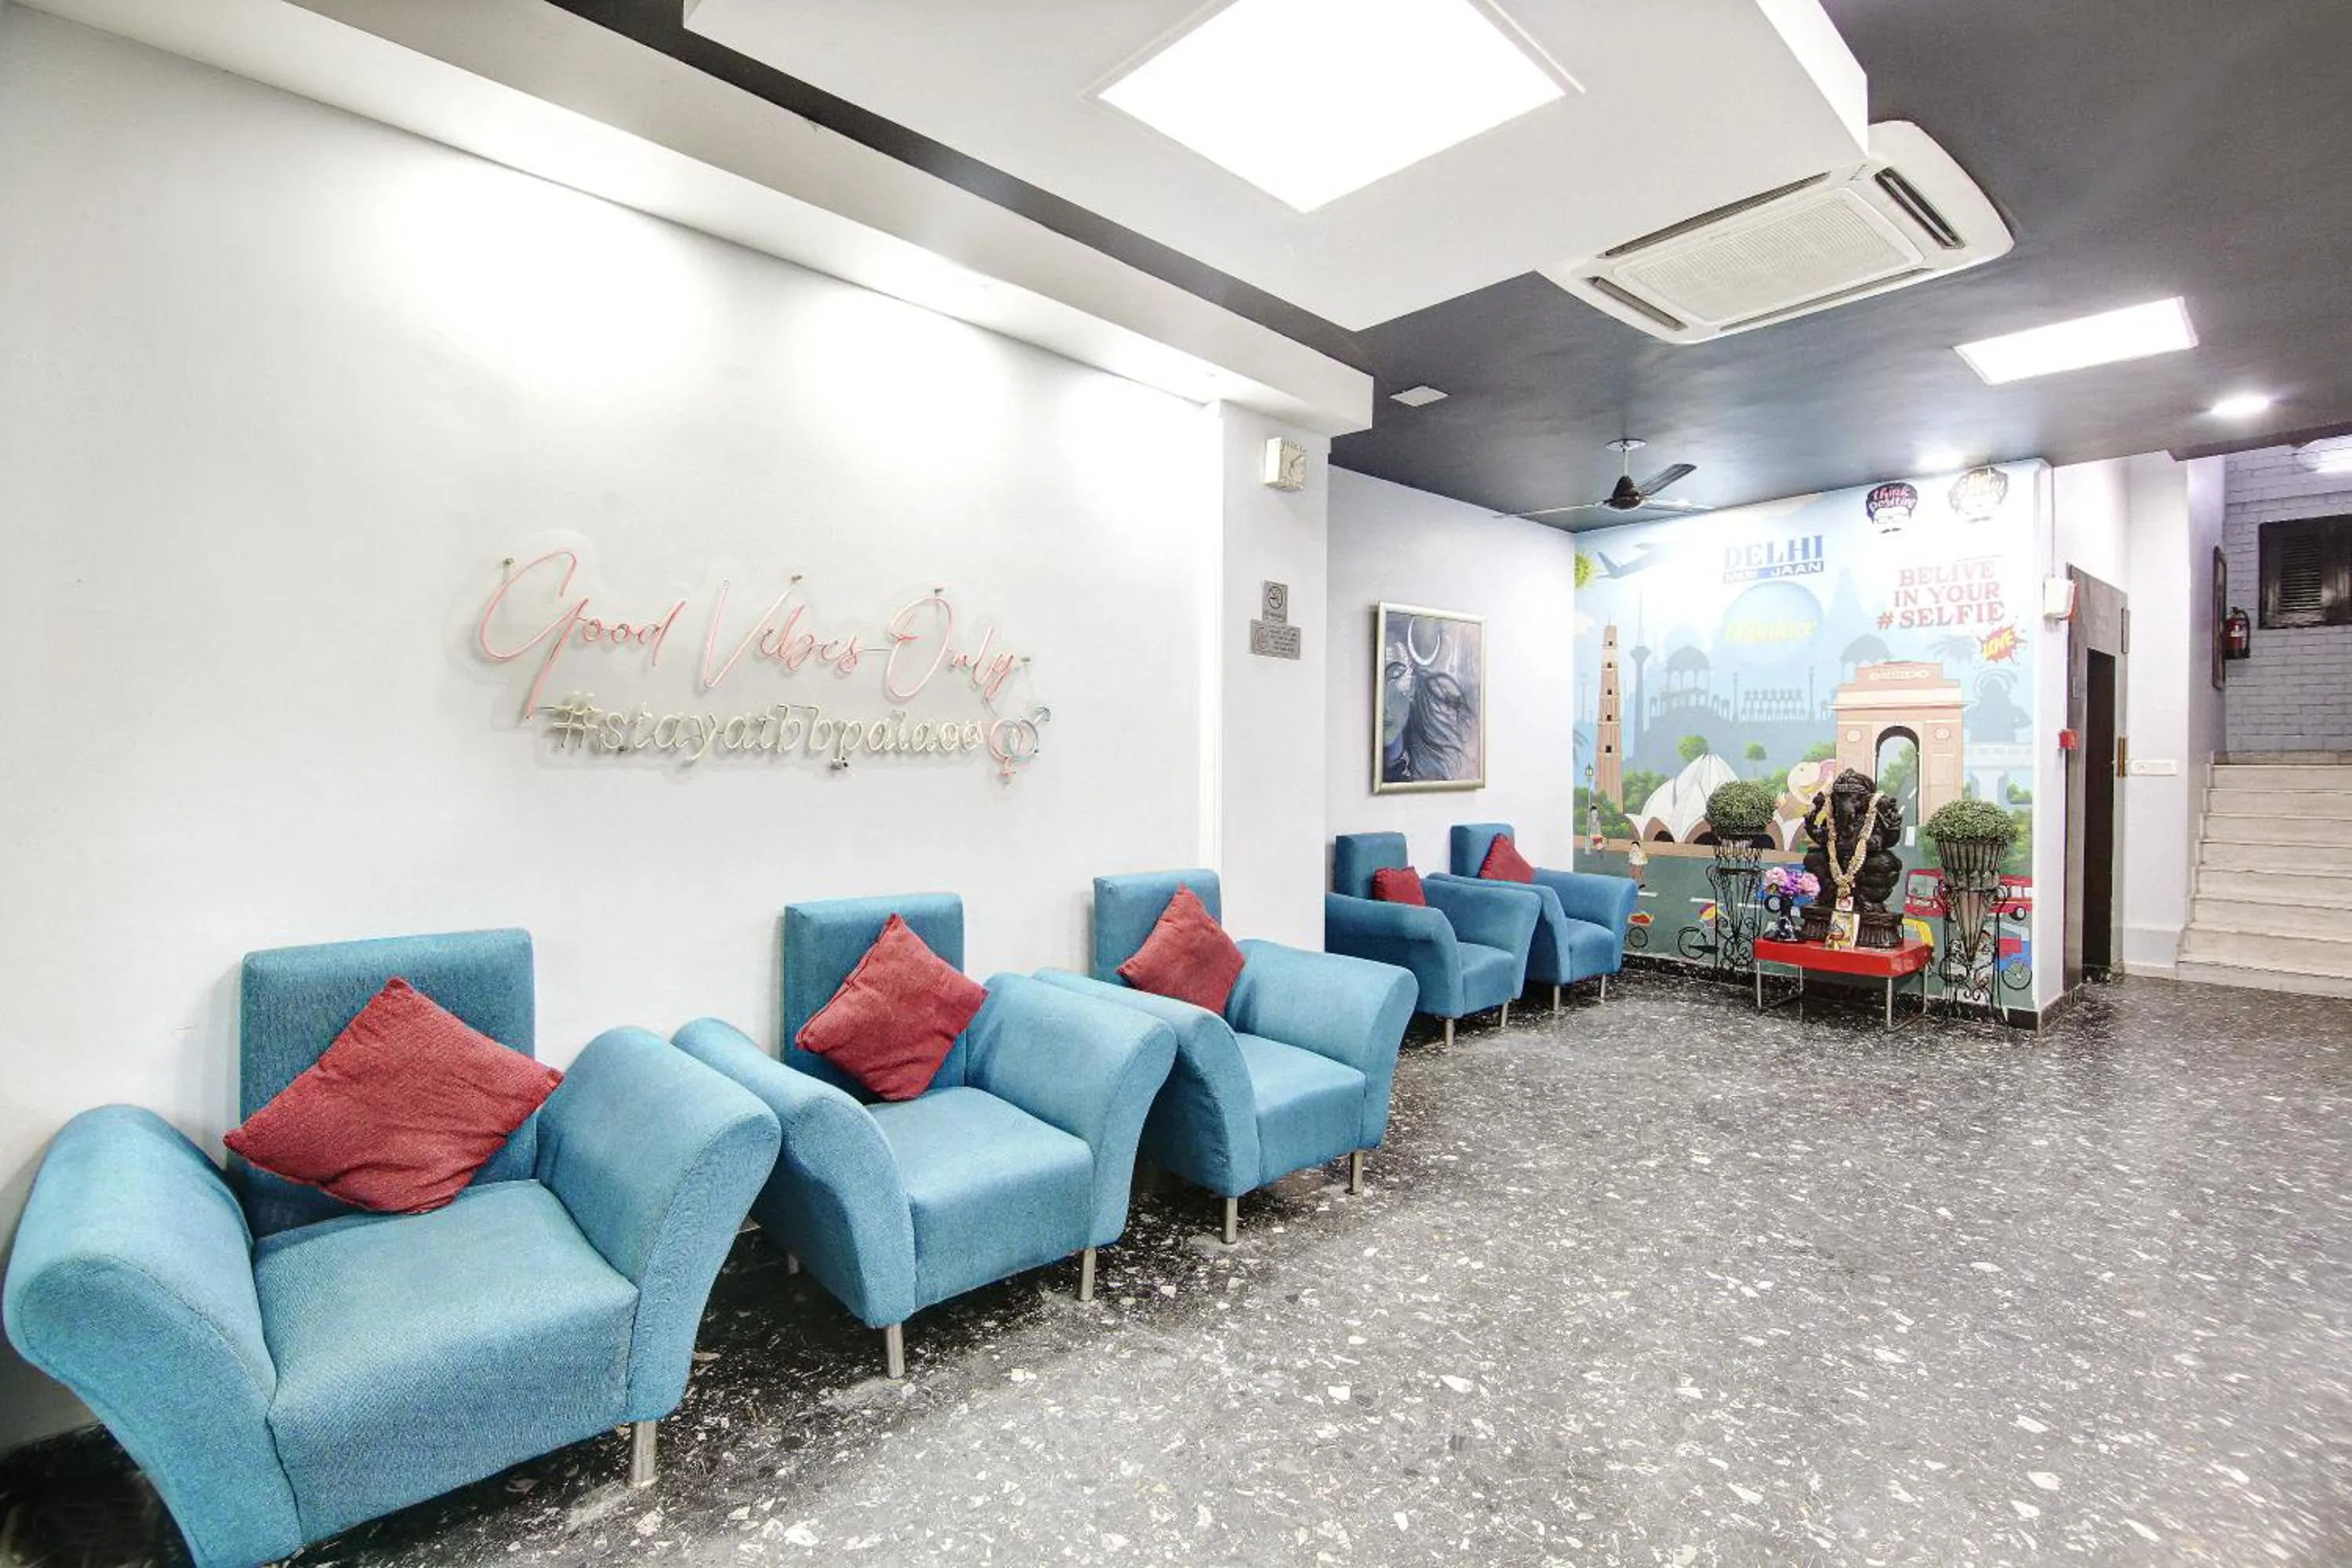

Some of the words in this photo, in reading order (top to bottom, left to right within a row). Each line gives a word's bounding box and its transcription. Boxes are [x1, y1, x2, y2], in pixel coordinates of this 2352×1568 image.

[1724, 534, 1824, 570] DELHI
[1898, 560, 1998, 587] BELIVE
[1893, 589, 1920, 608] IN
[1927, 580, 2001, 604] YOUR
[1876, 601, 2005, 630] #SELFIE
[479, 547, 688, 720] Good
[702, 579, 864, 689] Vibes
[885, 593, 1015, 702] Only
